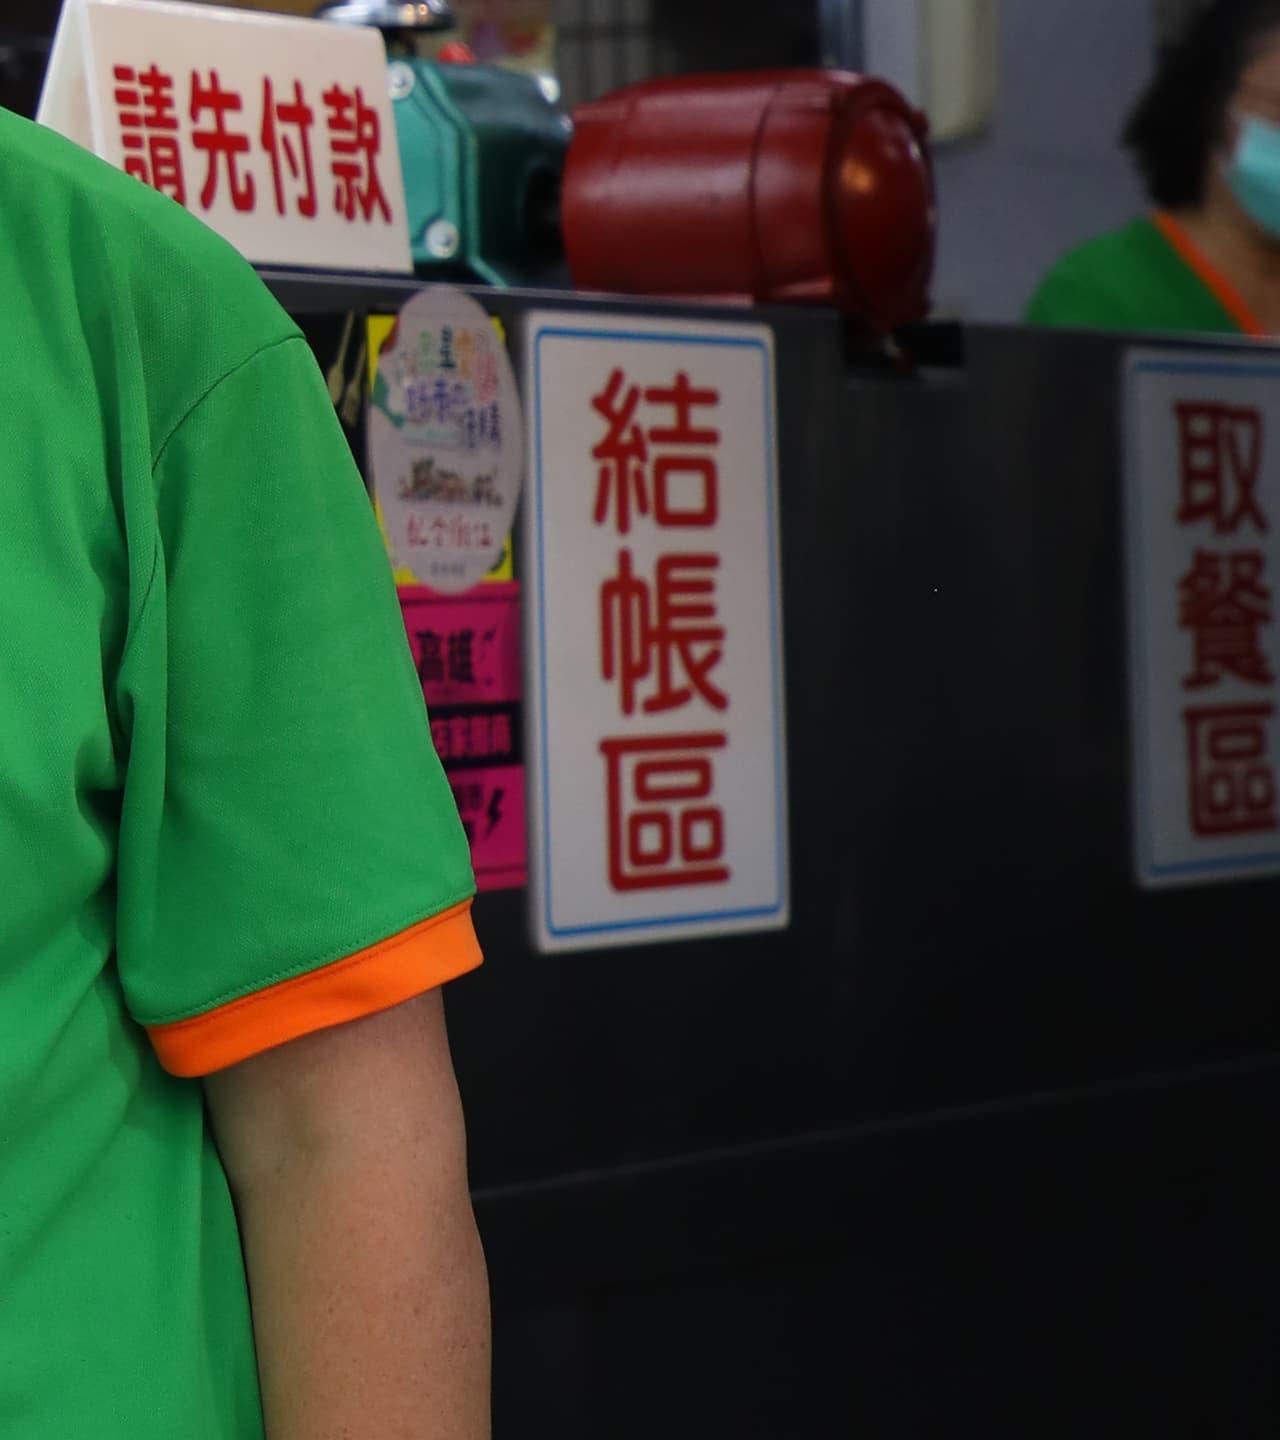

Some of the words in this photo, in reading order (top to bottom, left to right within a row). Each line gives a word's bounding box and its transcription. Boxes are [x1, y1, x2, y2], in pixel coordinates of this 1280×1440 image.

[112, 63, 393, 225] 請先付款
[590, 367, 730, 893] 結帳區
[1173, 400, 1280, 840] 取餐區
